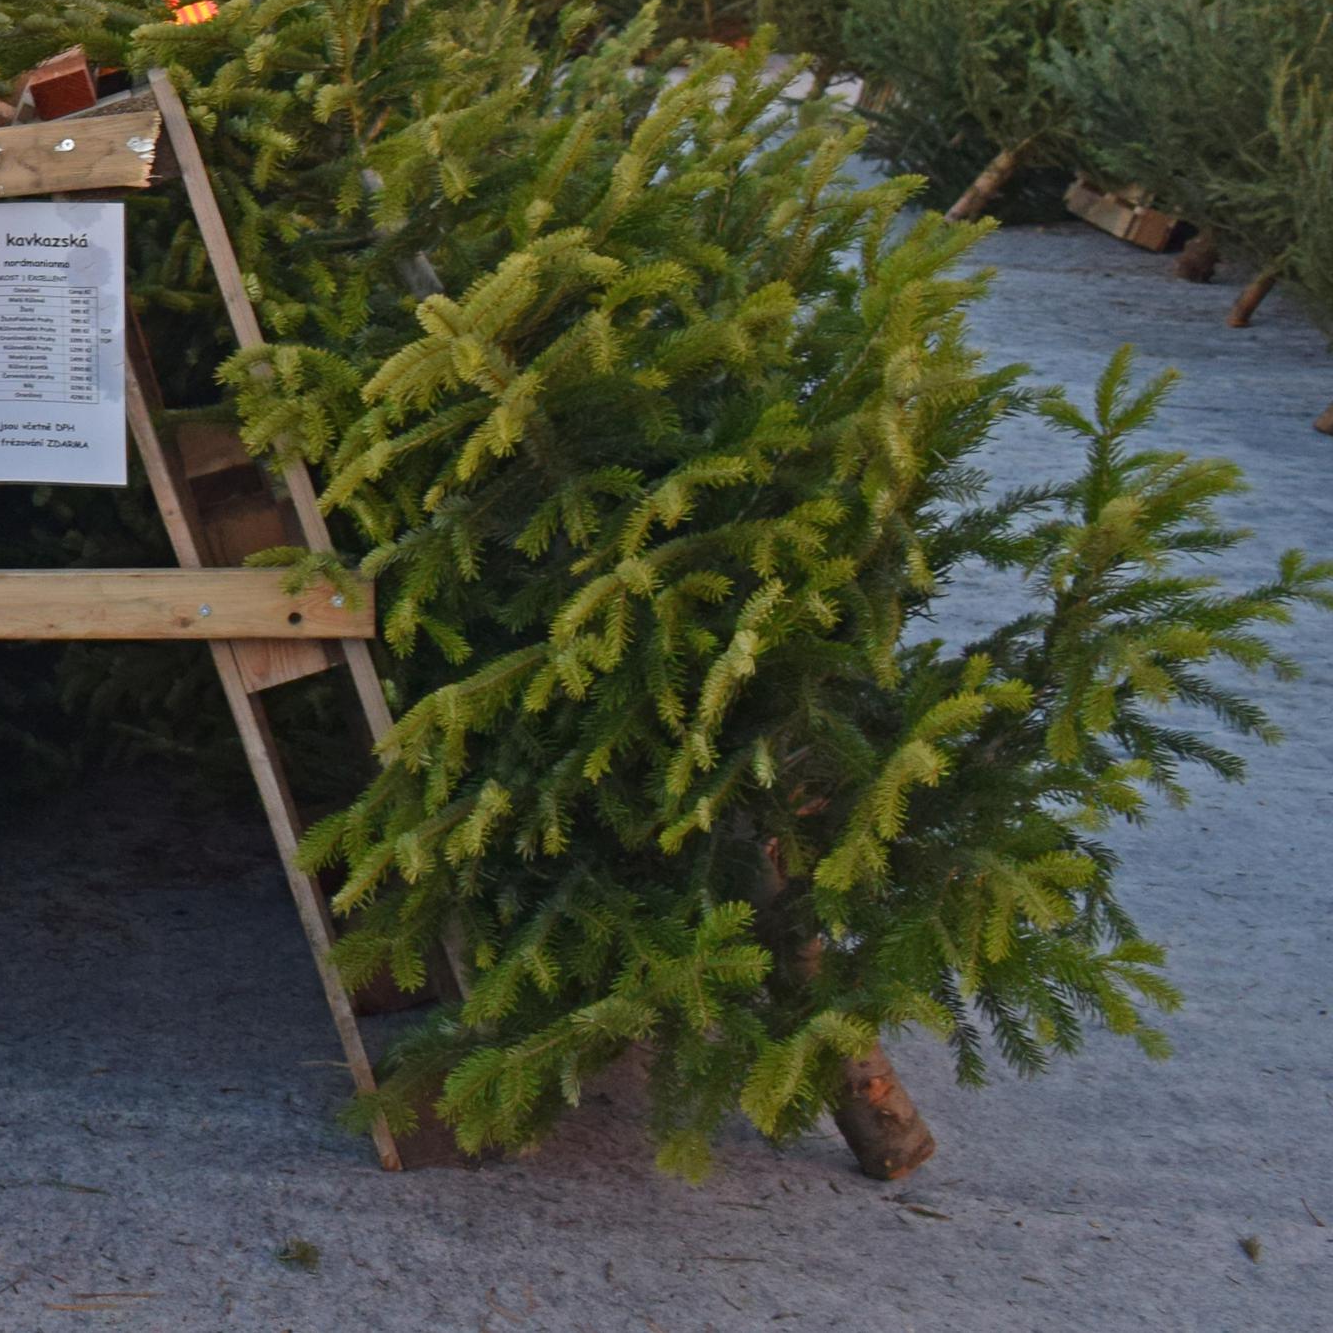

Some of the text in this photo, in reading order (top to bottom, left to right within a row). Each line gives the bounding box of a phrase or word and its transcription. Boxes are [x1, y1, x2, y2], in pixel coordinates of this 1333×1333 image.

[6, 233, 89, 248] kavkazská
[0, 422, 19, 432] jsou
[55, 423, 75, 432] DPH
